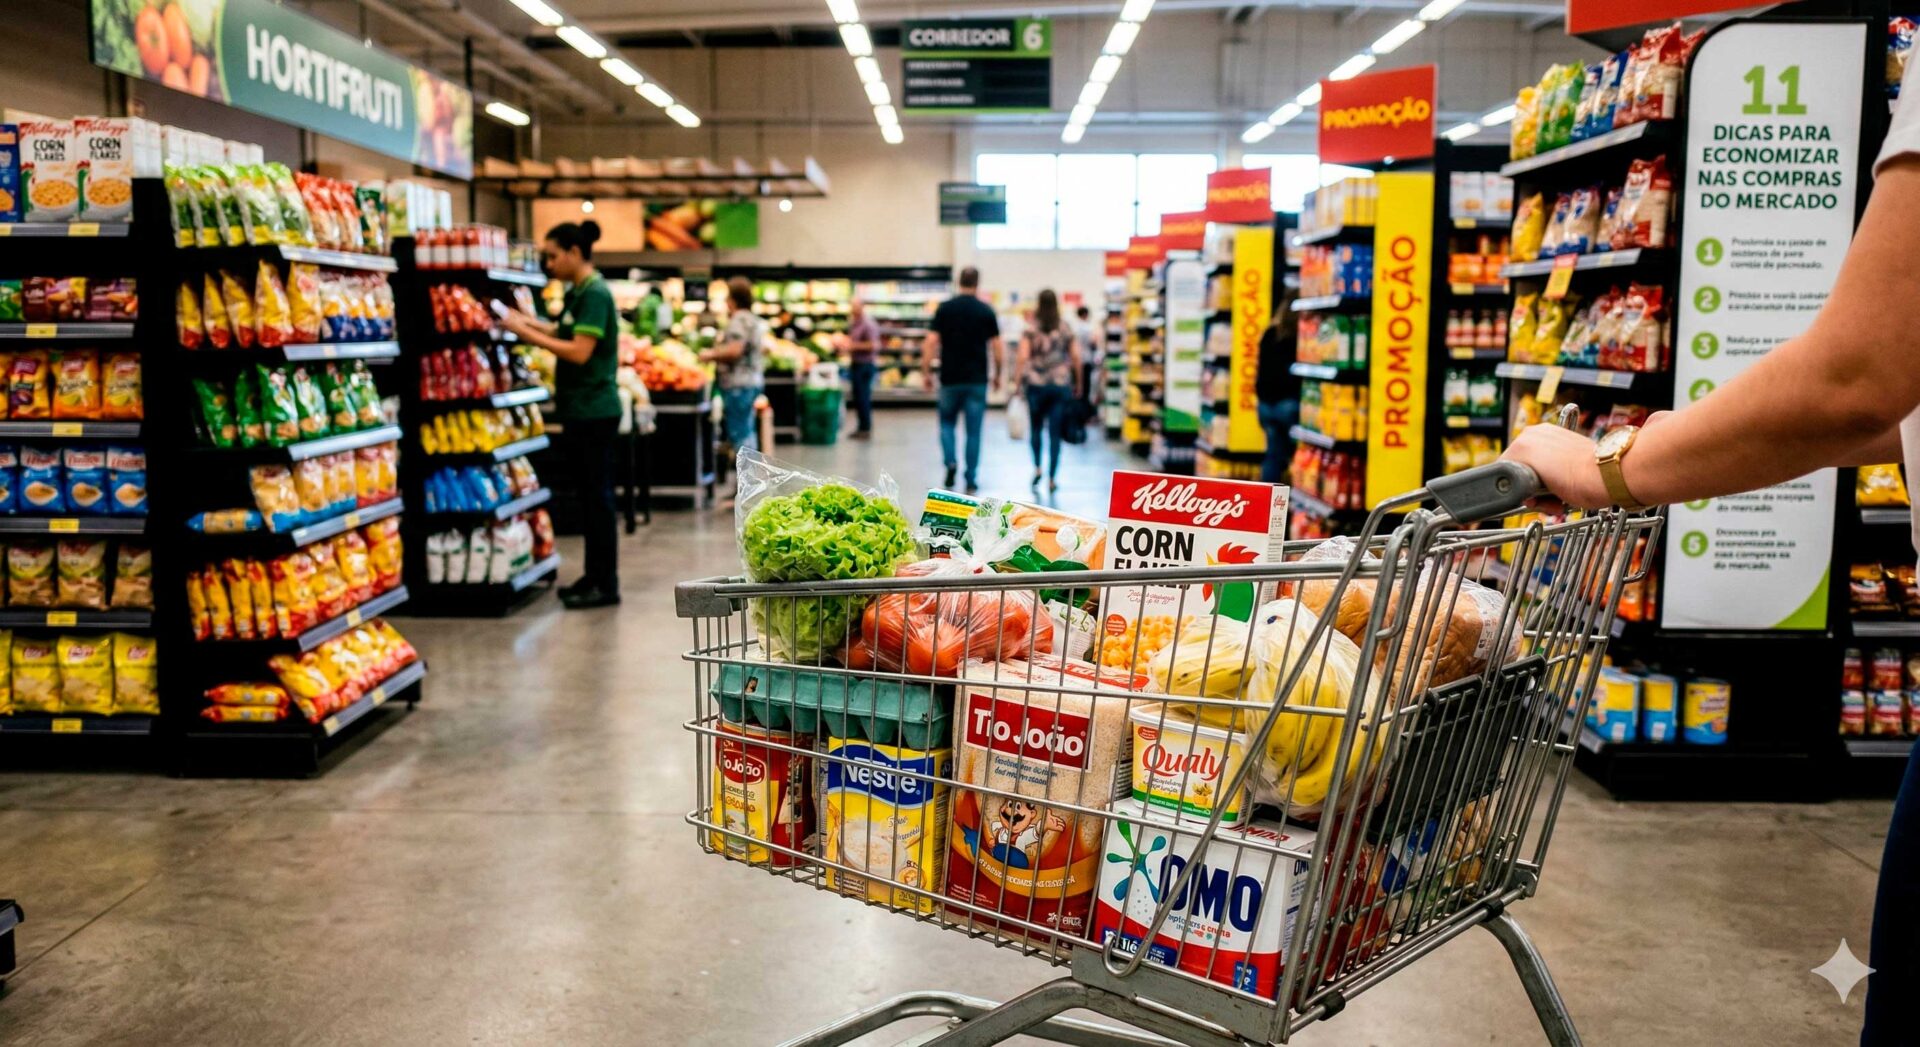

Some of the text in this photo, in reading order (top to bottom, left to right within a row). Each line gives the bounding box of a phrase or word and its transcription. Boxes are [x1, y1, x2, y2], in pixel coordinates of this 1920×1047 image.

[909, 23, 1043, 50] CORREDOR 6
[246, 23, 404, 131] HORTIFRUTI
[1742, 65, 1807, 115] 11
[1323, 96, 1430, 131] PROMOÇÃO
[33, 138, 65, 152] CORN
[89, 136, 121, 150] CORN
[1714, 125, 1831, 141] DICAS PARA
[1703, 147, 1839, 163] ECONOMIZAR
[1698, 170, 1842, 186] NAS COMPRAS
[1701, 193, 1837, 209] DO MERCADO
[1703, 242, 1716, 261] 1
[1700, 290, 1714, 309] 2
[1239, 268, 1264, 411] PROMOÇÃO
[1383, 236, 1423, 449] PROMOÇÃO
[1698, 337, 1712, 355] 3
[1132, 478, 1247, 527] Kellogg's
[1115, 526, 1195, 562] CORN
[974, 708, 1084, 757] Tio João
[732, 758, 761, 777] João
[843, 756, 917, 794] Nesté
[1142, 743, 1225, 781] Qualy
[1294, 859, 1310, 877] OM
[1160, 854, 1264, 933] OMO
